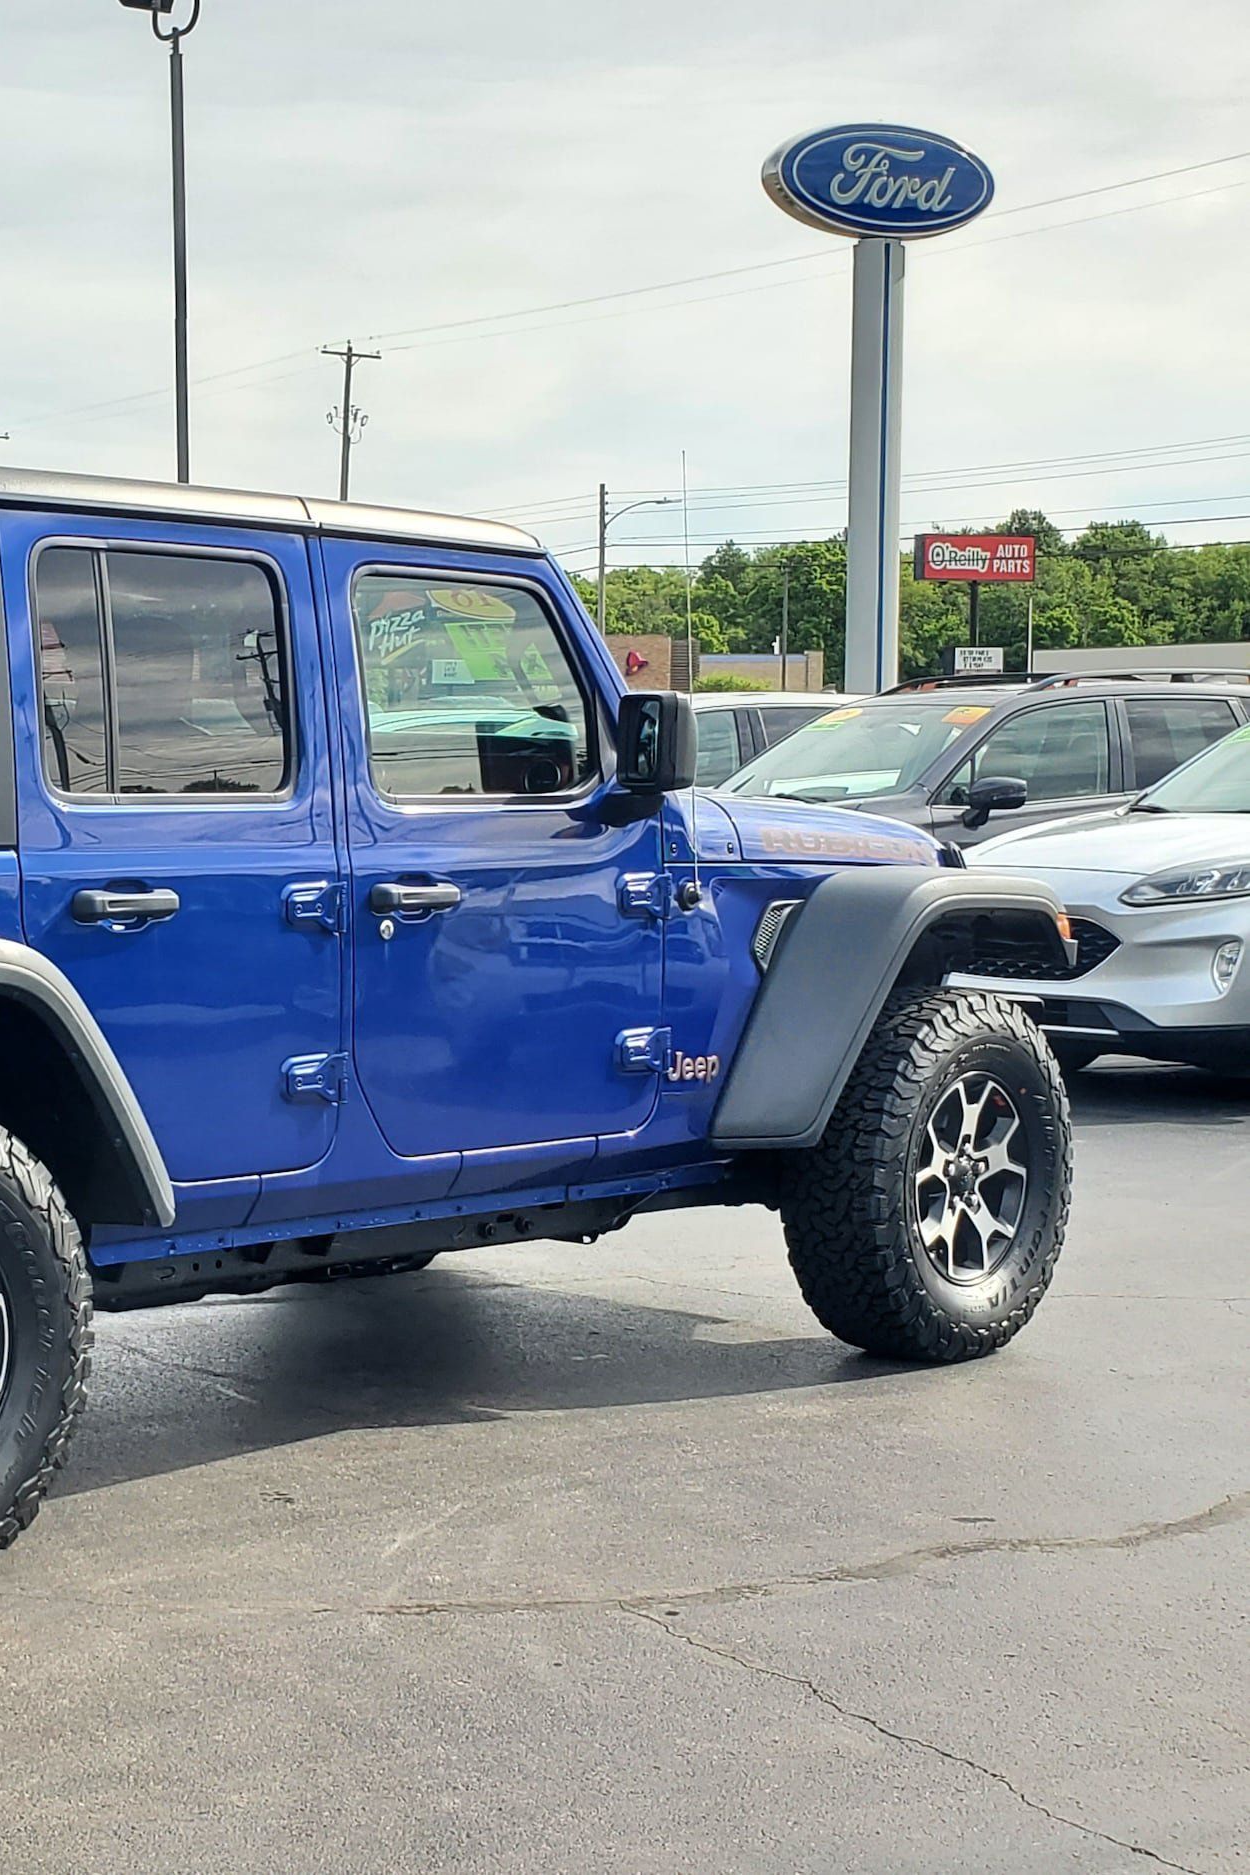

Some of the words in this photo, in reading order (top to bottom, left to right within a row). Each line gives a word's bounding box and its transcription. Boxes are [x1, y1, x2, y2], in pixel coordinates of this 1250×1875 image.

[830, 143, 956, 212] Ford
[929, 543, 990, 572] O'Reilly
[993, 559, 1030, 574] PARTS
[996, 544, 1028, 558] AUTO
[369, 611, 426, 651] Pizza
[378, 626, 421, 657] Hut
[761, 829, 937, 867] RUBICON
[668, 1051, 720, 1084] Jeep
